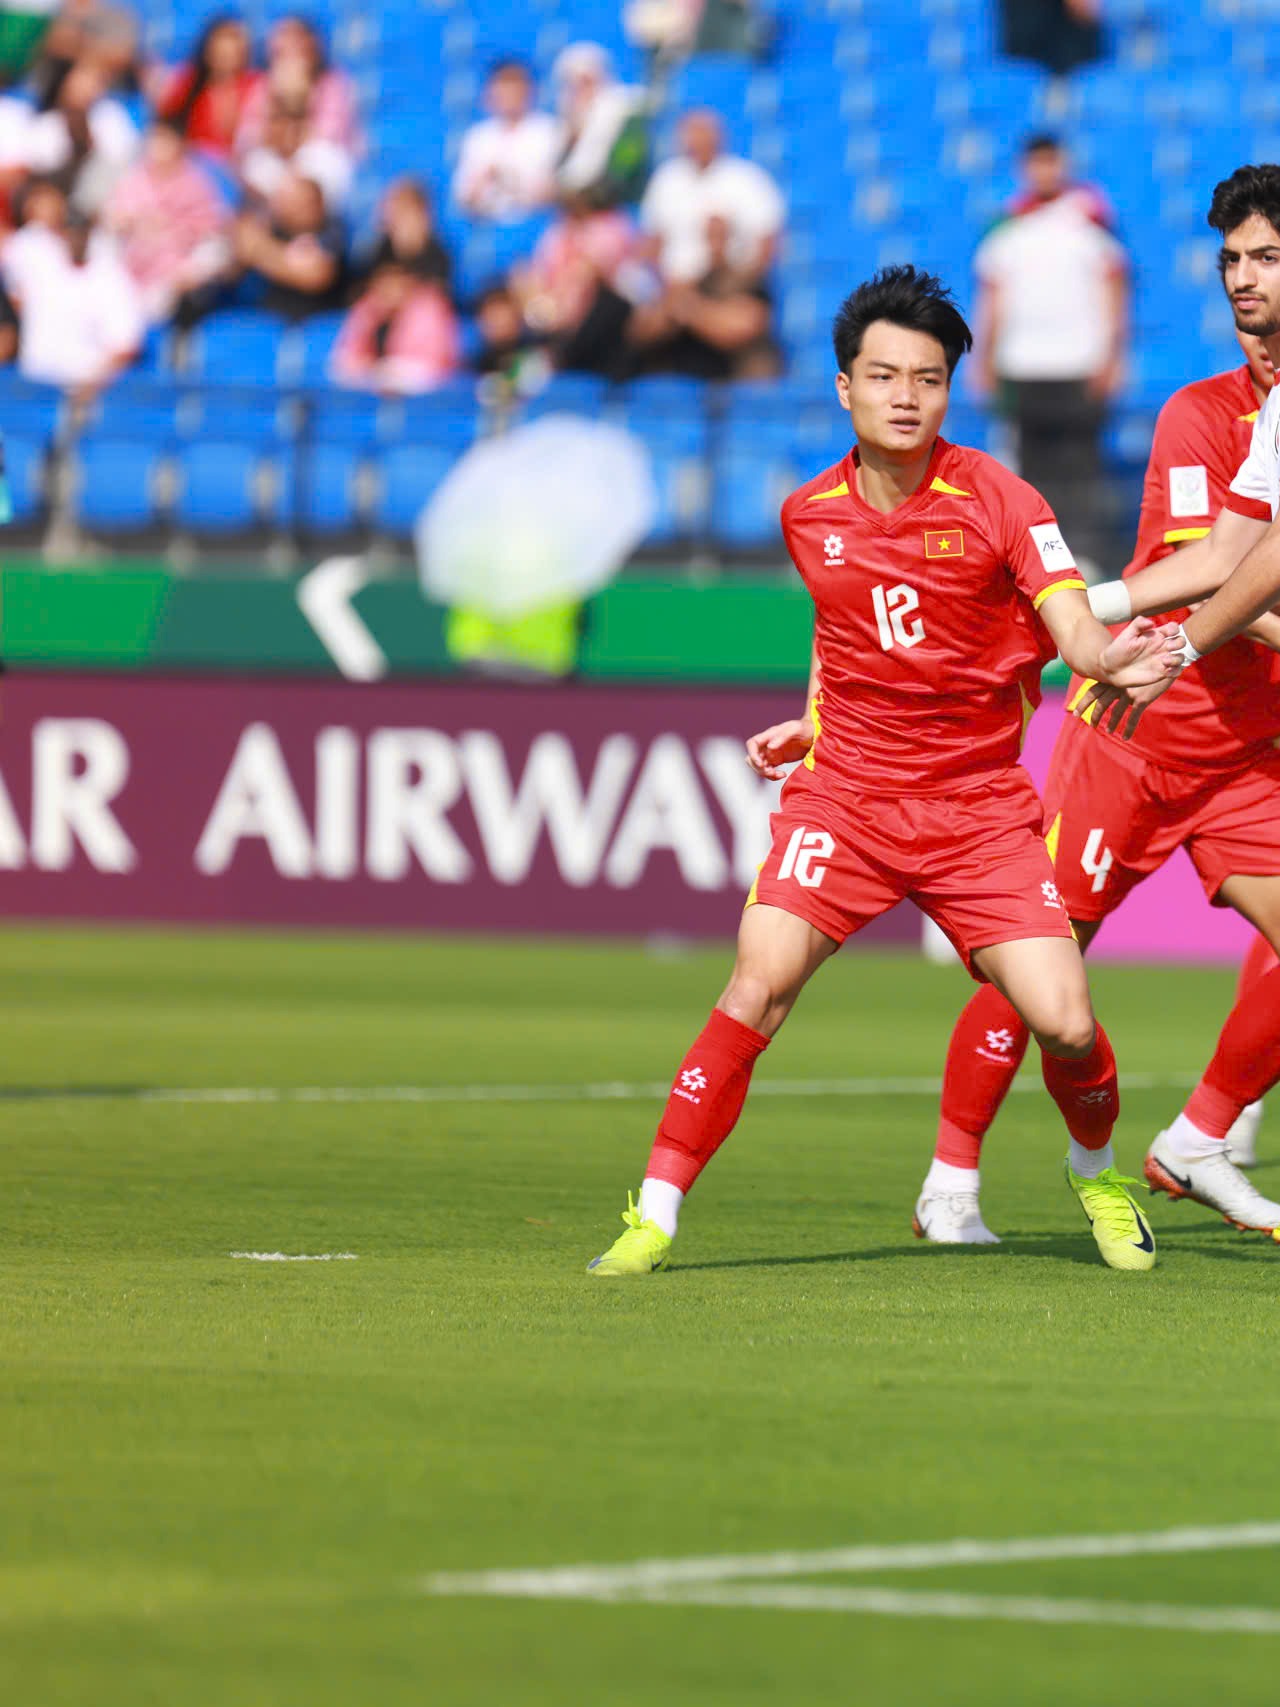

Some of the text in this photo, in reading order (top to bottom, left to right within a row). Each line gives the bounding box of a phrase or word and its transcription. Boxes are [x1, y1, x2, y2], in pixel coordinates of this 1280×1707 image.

[871, 583, 927, 652] 12
[0, 716, 139, 874] R
[776, 826, 836, 888] 12
[1080, 828, 1114, 893] 4
